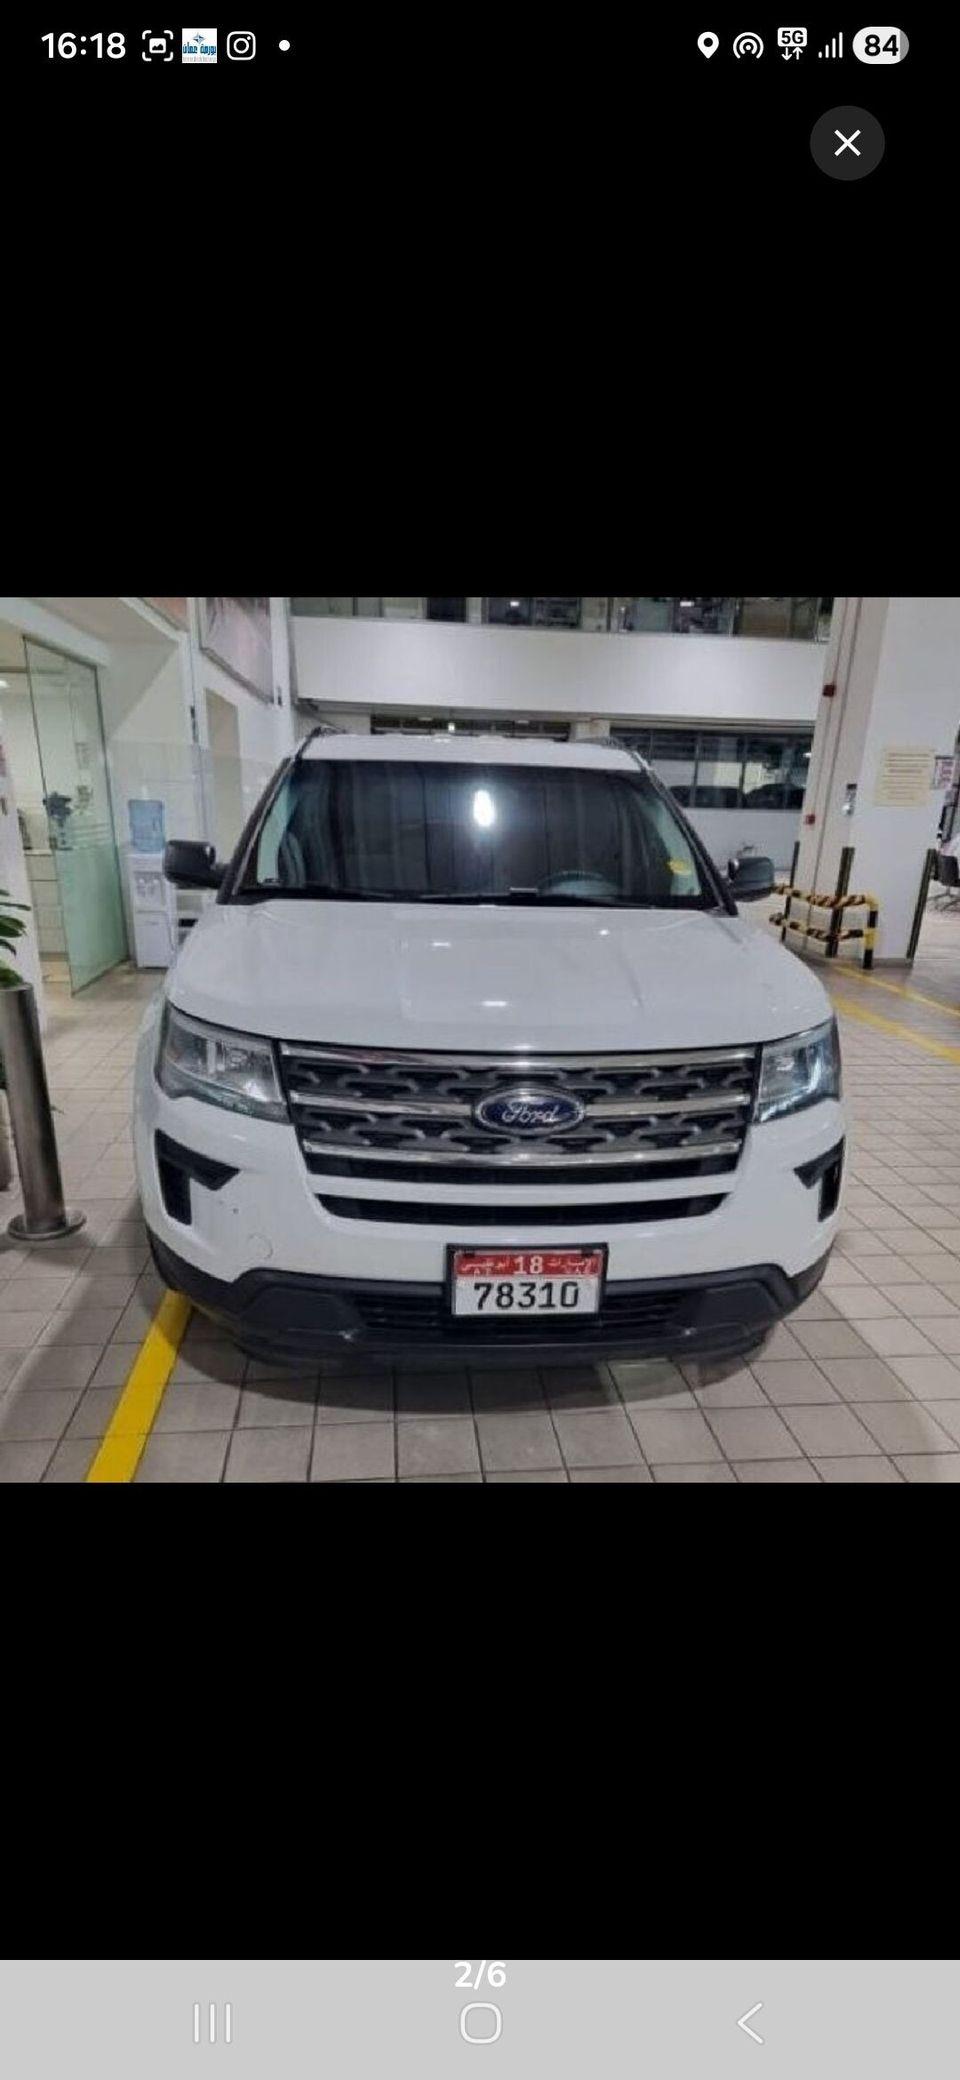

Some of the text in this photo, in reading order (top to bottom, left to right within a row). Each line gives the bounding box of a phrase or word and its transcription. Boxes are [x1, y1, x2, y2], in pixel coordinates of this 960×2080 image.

[501, 1100, 562, 1123] Ford
[513, 1255, 543, 1275] 18
[473, 1281, 579, 1311] 78310
